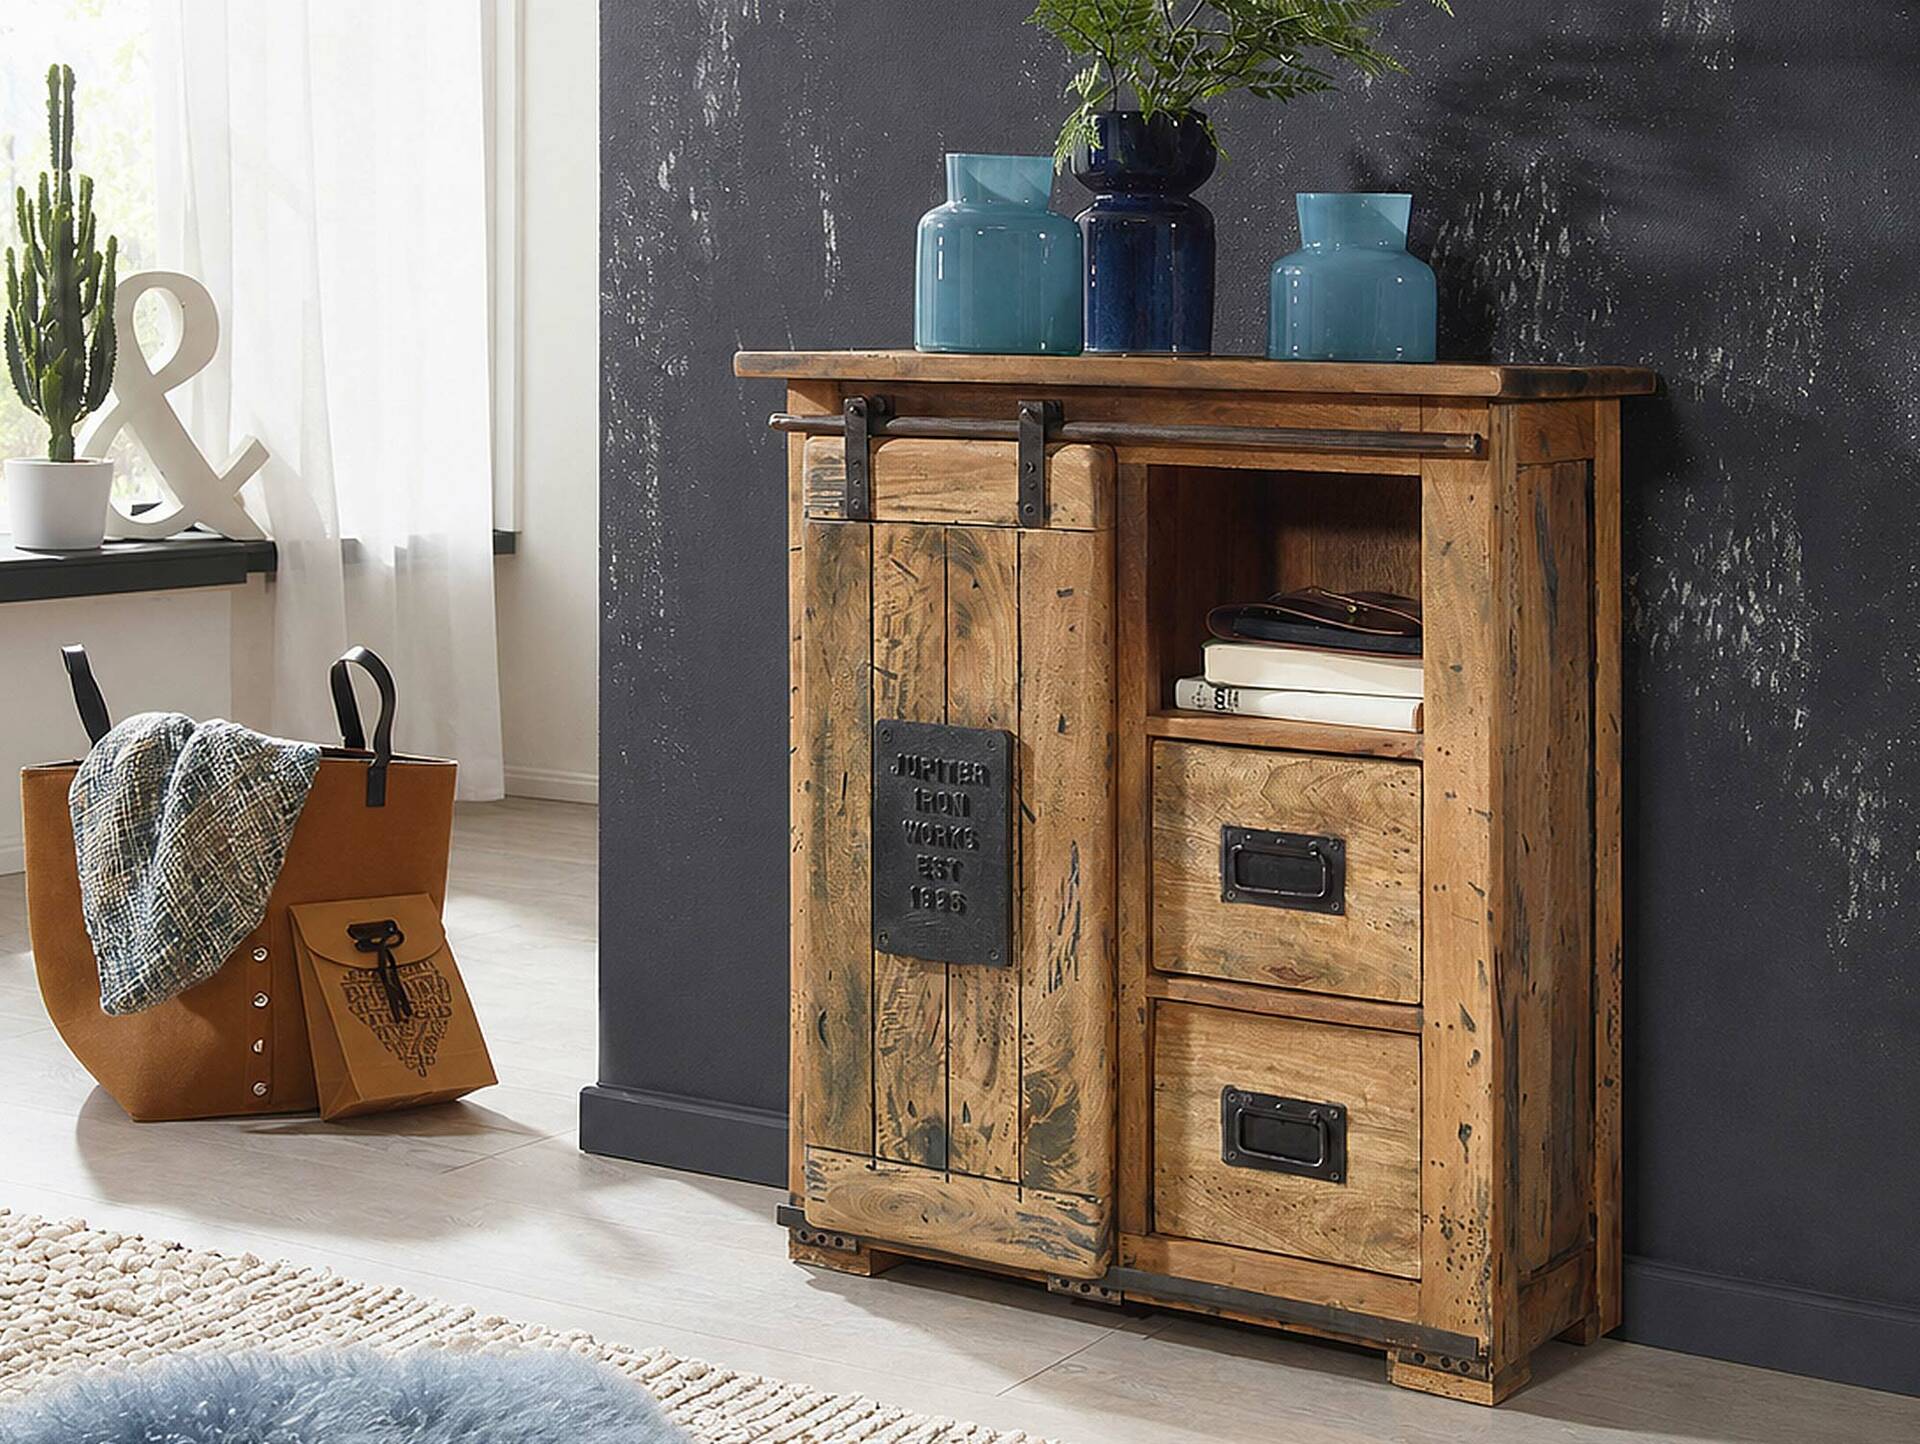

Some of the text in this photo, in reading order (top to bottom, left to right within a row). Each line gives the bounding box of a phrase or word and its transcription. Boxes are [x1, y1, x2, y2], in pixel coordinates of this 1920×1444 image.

[79, 271, 271, 541] &
[889, 752, 991, 786] JUPITER
[912, 787, 970, 817] IRON
[900, 818, 981, 850] WORKS
[915, 854, 965, 882] EST
